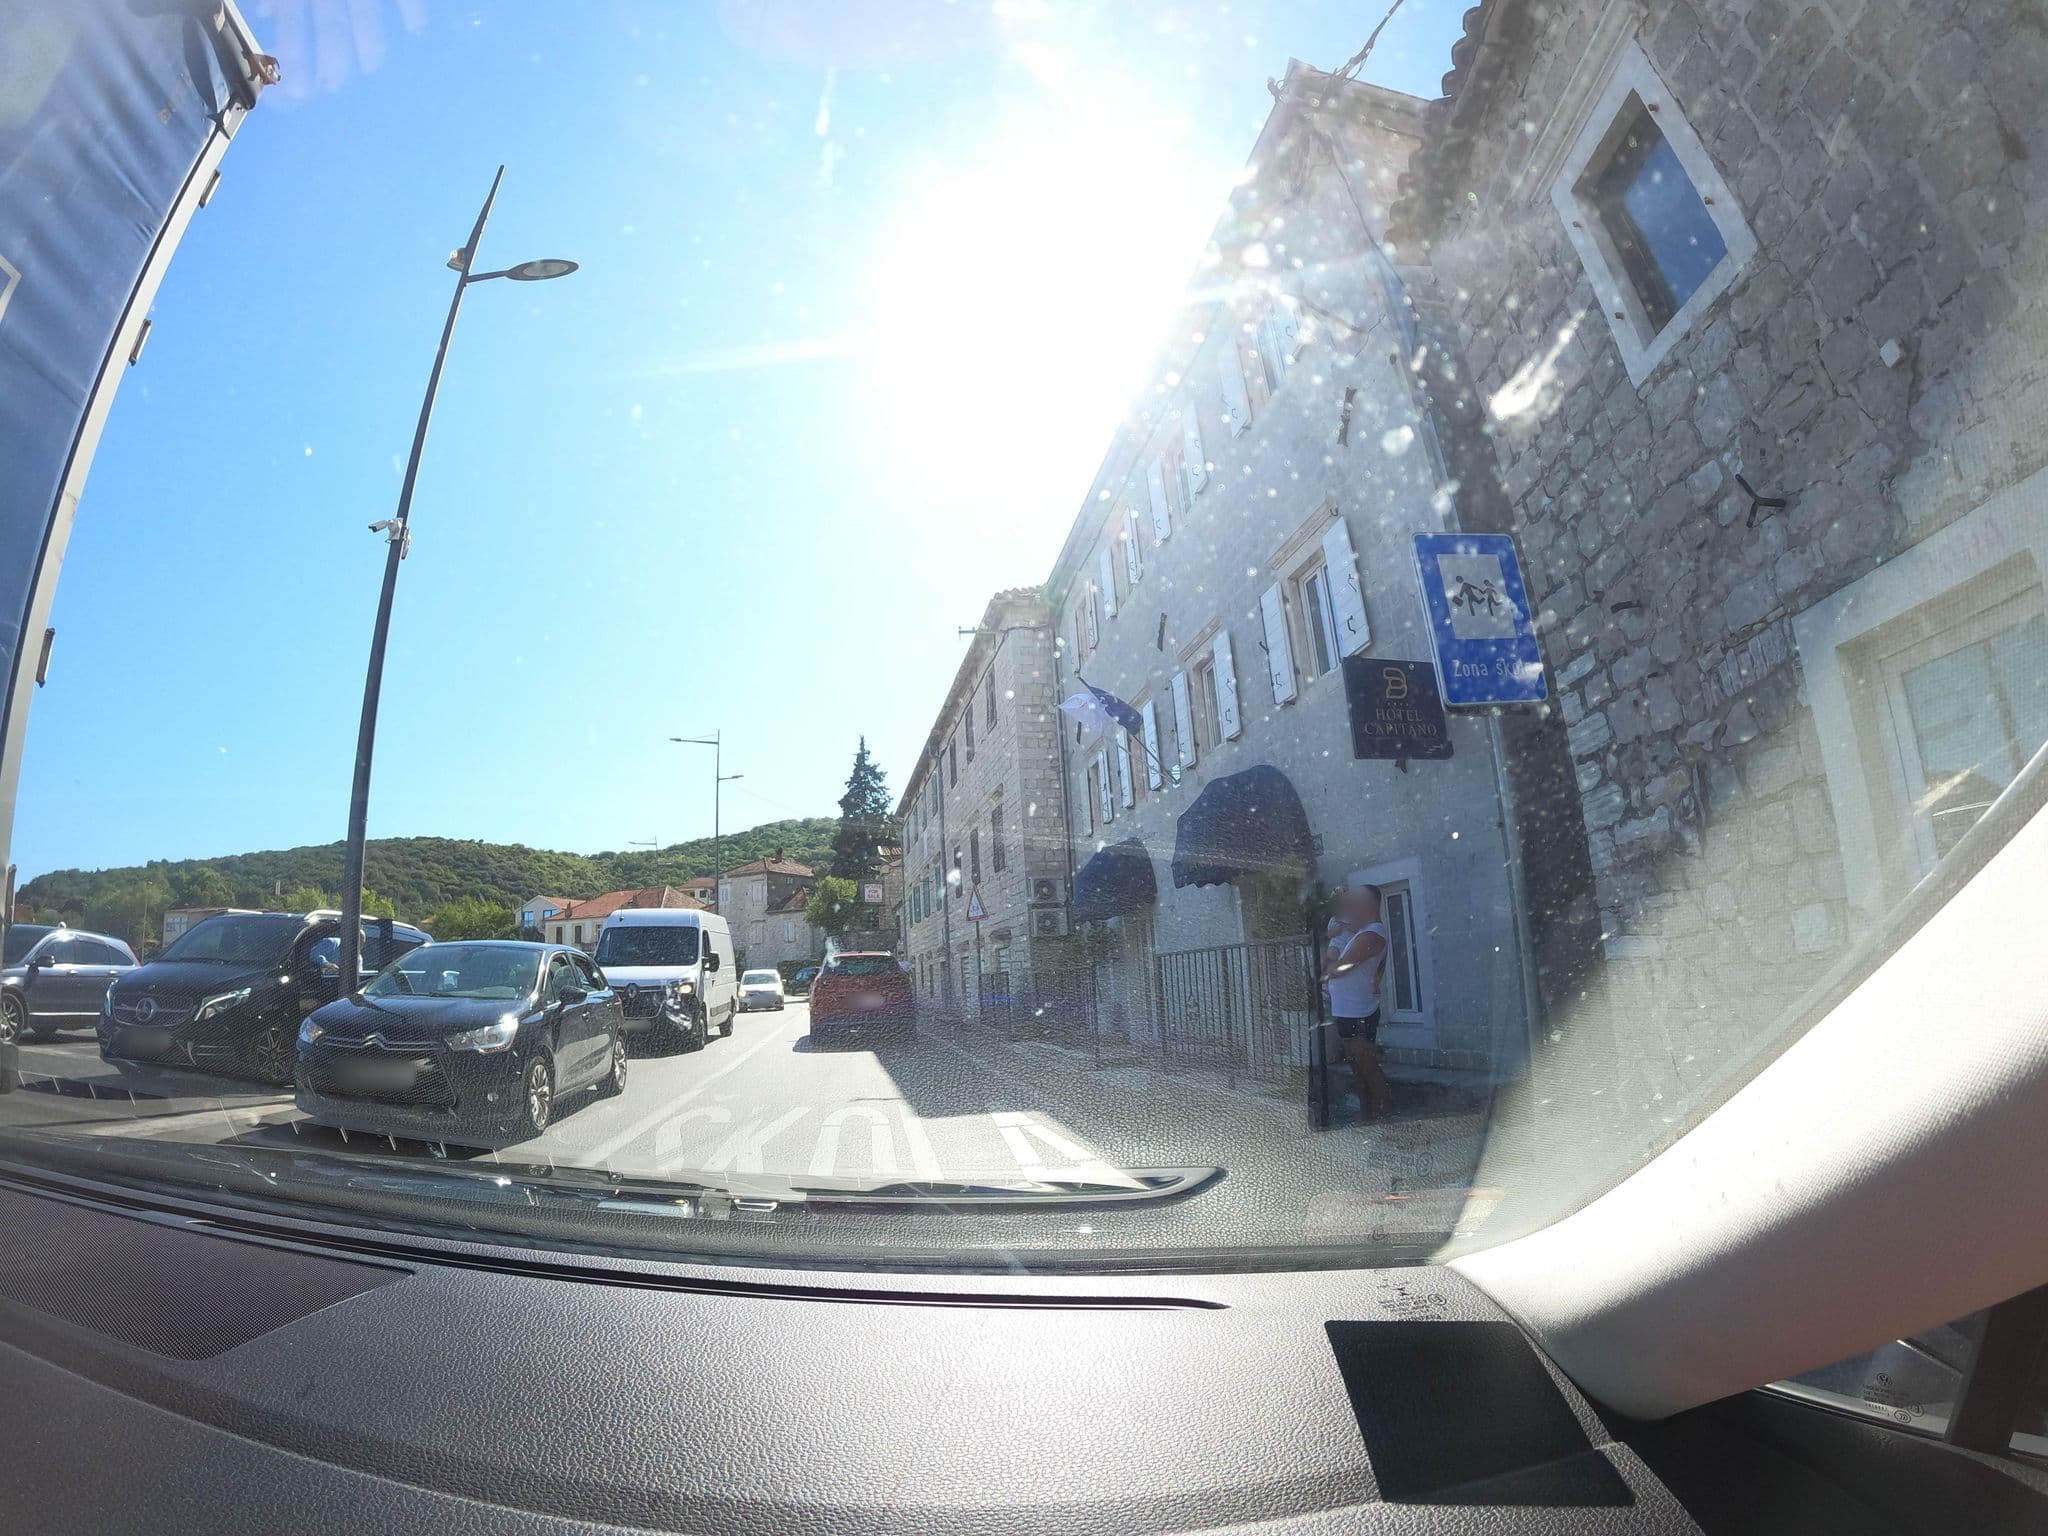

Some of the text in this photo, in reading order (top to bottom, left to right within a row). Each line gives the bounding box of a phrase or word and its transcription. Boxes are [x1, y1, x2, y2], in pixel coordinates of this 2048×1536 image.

[1452, 659, 1489, 677] Zona
[1376, 708, 1424, 722] HOTEL
[1364, 722, 1437, 737] CAPITANO
